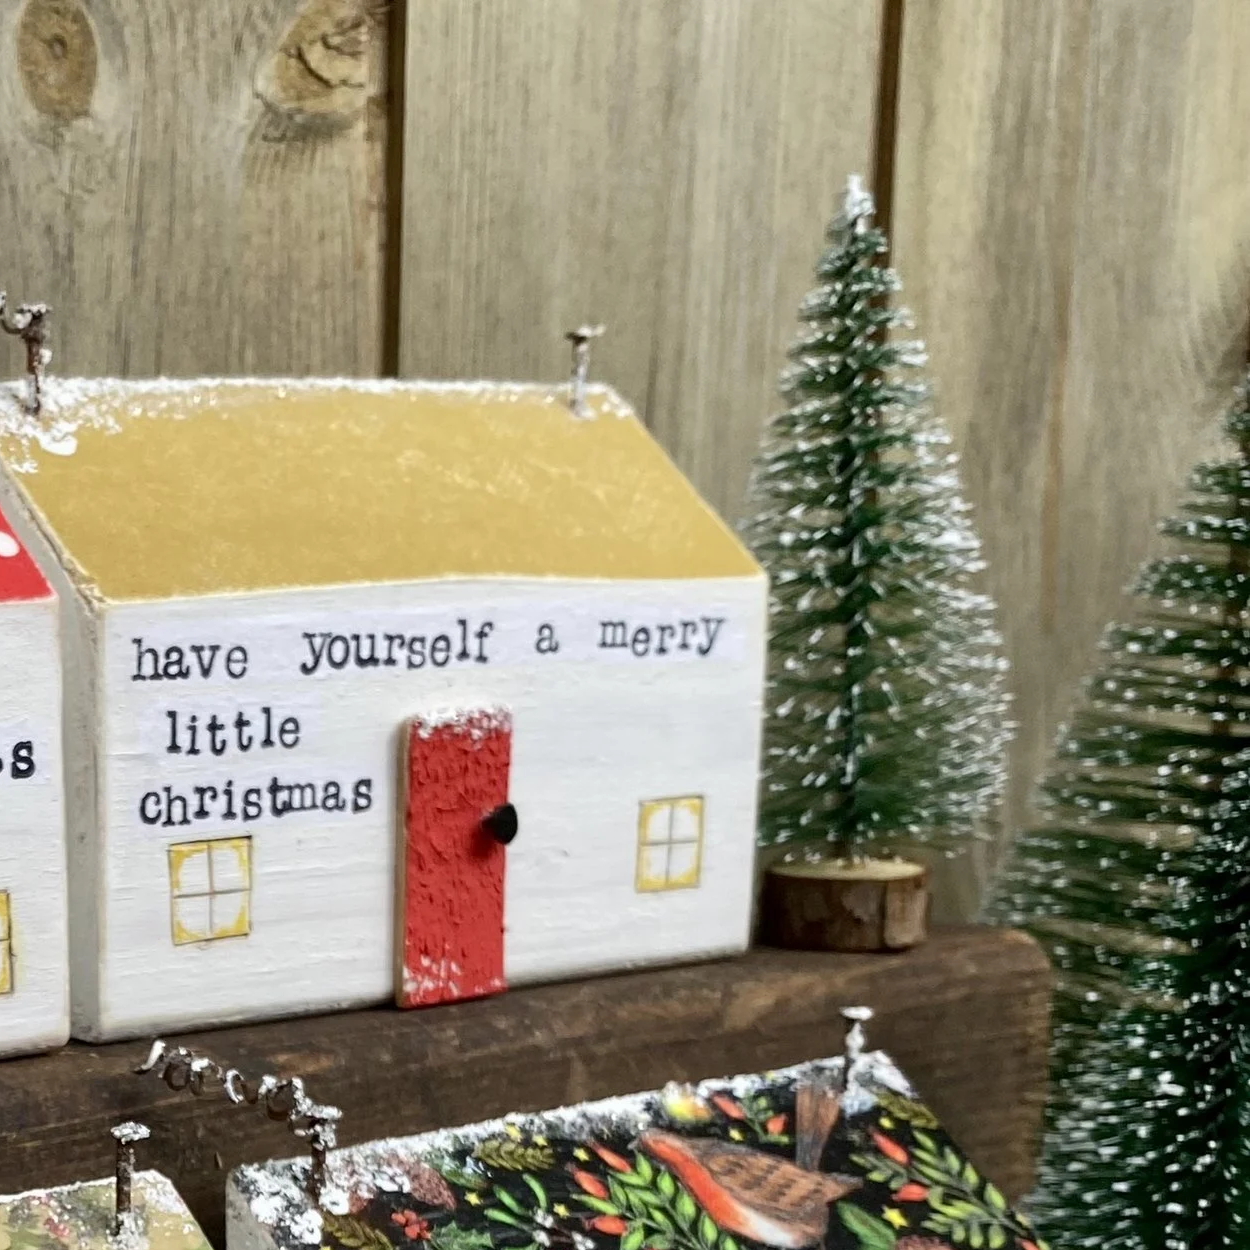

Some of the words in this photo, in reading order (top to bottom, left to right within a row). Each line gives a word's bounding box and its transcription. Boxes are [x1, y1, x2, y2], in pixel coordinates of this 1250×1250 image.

[131, 638, 248, 682] have
[300, 619, 493, 676] yourself
[535, 623, 559, 654] a
[597, 616, 726, 657] merry
[166, 706, 300, 757] little
[139, 776, 372, 828] christmas
